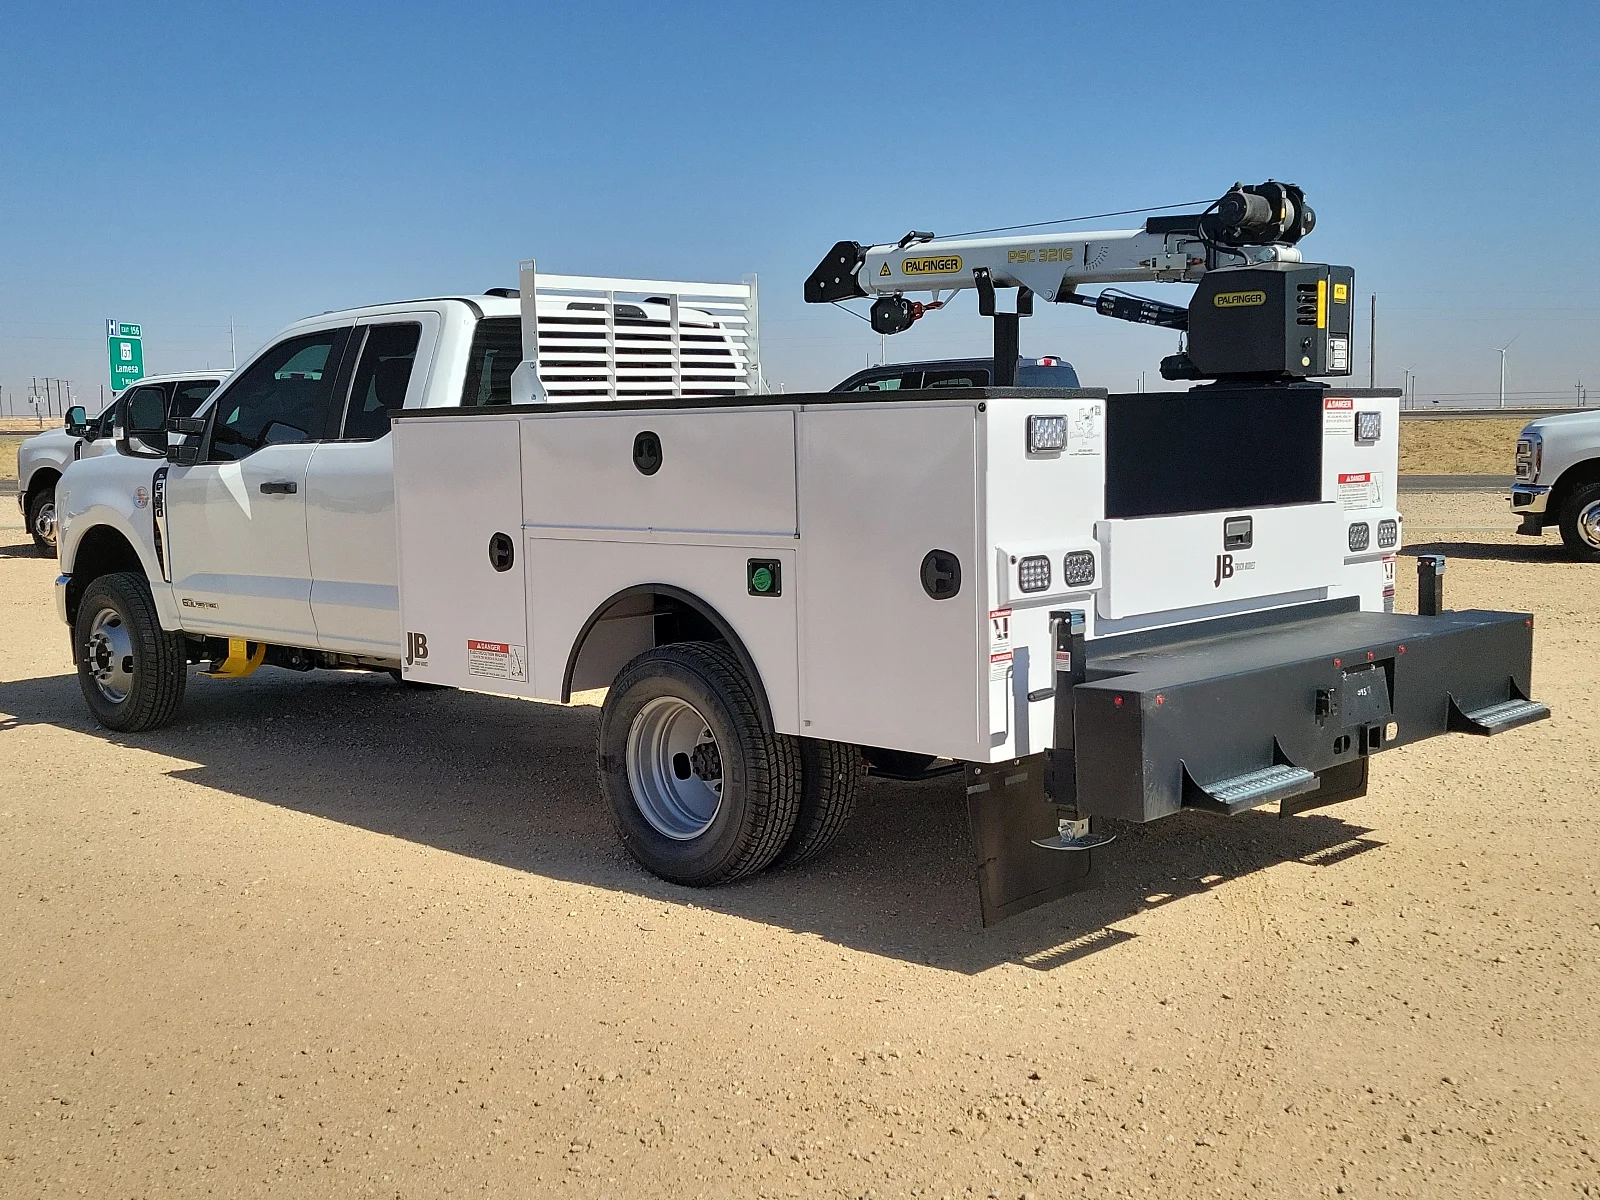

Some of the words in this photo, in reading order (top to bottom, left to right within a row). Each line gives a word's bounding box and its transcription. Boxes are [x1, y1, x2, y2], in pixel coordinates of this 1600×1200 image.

[1008, 251, 1035, 263] PSC
[1039, 247, 1073, 261] 3216
[905, 259, 958, 272] PALFINGER
[1217, 294, 1262, 305] PALFINGER
[131, 325, 140, 335] 156
[121, 349, 131, 359] 137
[115, 364, 139, 374] Lamesa
[1213, 554, 1234, 588] JB
[405, 631, 429, 666] JB
[481, 643, 501, 652] DANGER
